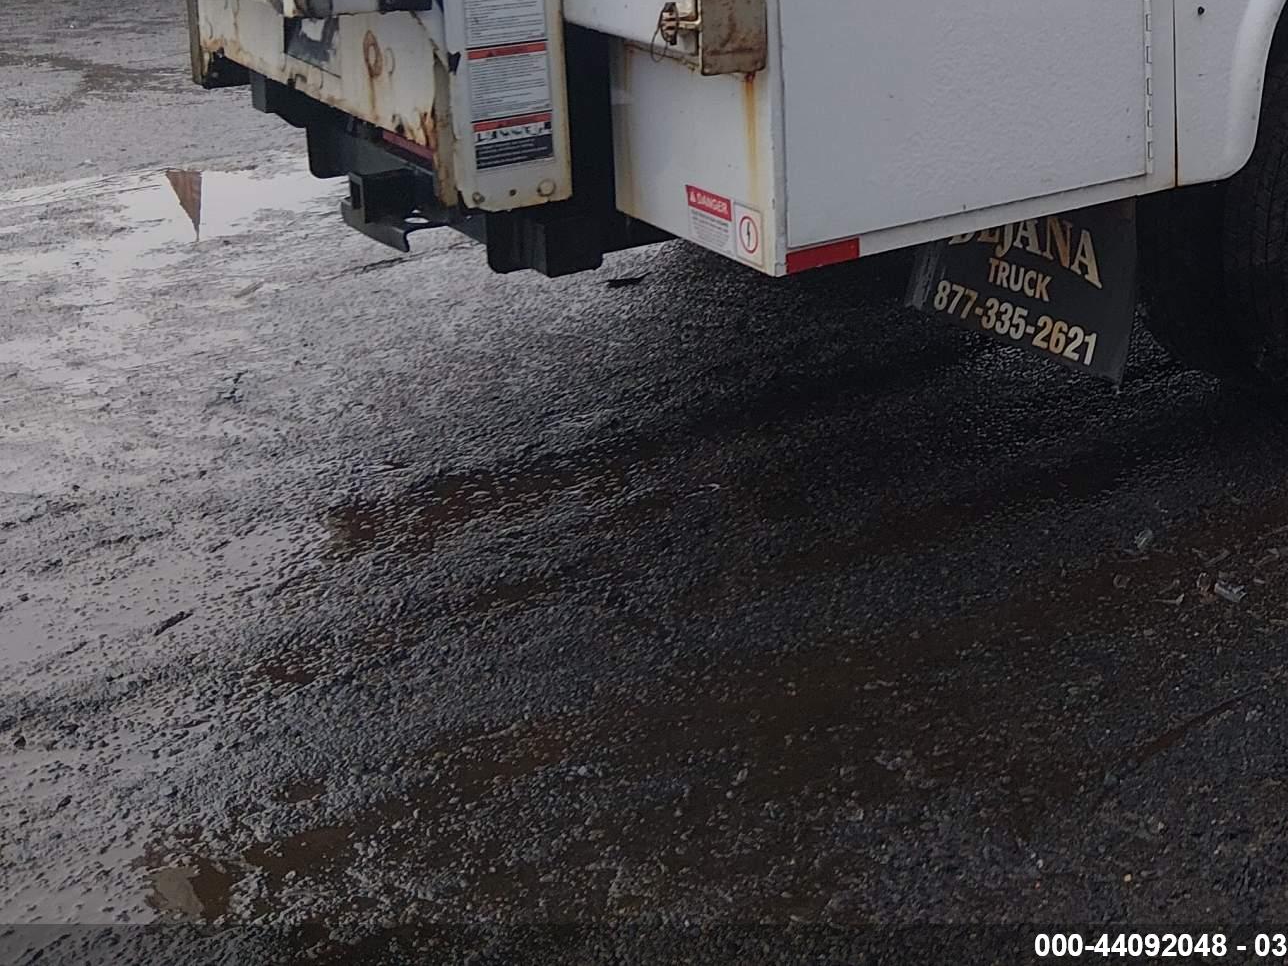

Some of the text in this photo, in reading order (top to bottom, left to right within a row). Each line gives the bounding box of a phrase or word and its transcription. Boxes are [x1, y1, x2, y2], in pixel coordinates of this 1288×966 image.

[696, 192, 729, 215] DANGER
[986, 257, 1053, 303] TRUCK
[933, 279, 1098, 367] 877-335-2621
